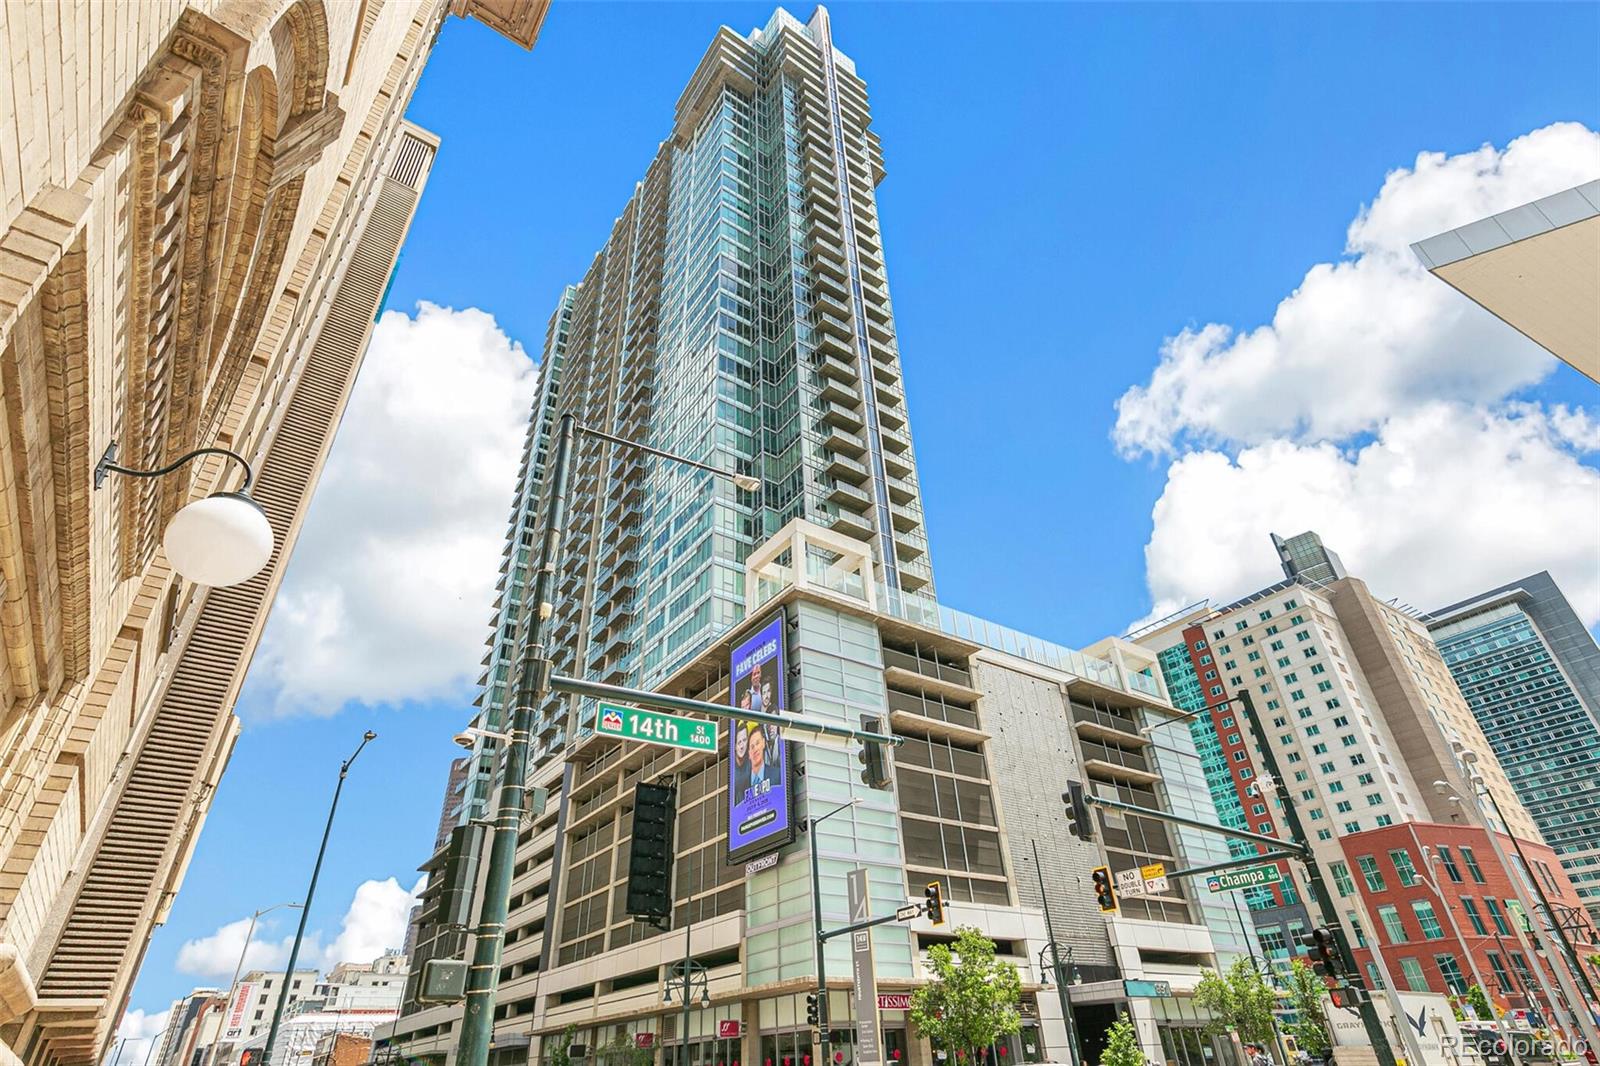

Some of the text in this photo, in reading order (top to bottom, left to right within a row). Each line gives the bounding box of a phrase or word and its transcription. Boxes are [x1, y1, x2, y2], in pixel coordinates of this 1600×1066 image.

[736, 657, 753, 677] FAVE
[753, 639, 777, 664] CELEBS
[629, 714, 679, 742] 14th
[696, 725, 705, 735] St
[690, 734, 711, 745] 1400
[1122, 872, 1134, 881] NO
[1219, 870, 1265, 888] Champa
[1120, 880, 1142, 890] DOUBLE
[1125, 888, 1141, 896] TURN
[226, 1028, 242, 1037] art
